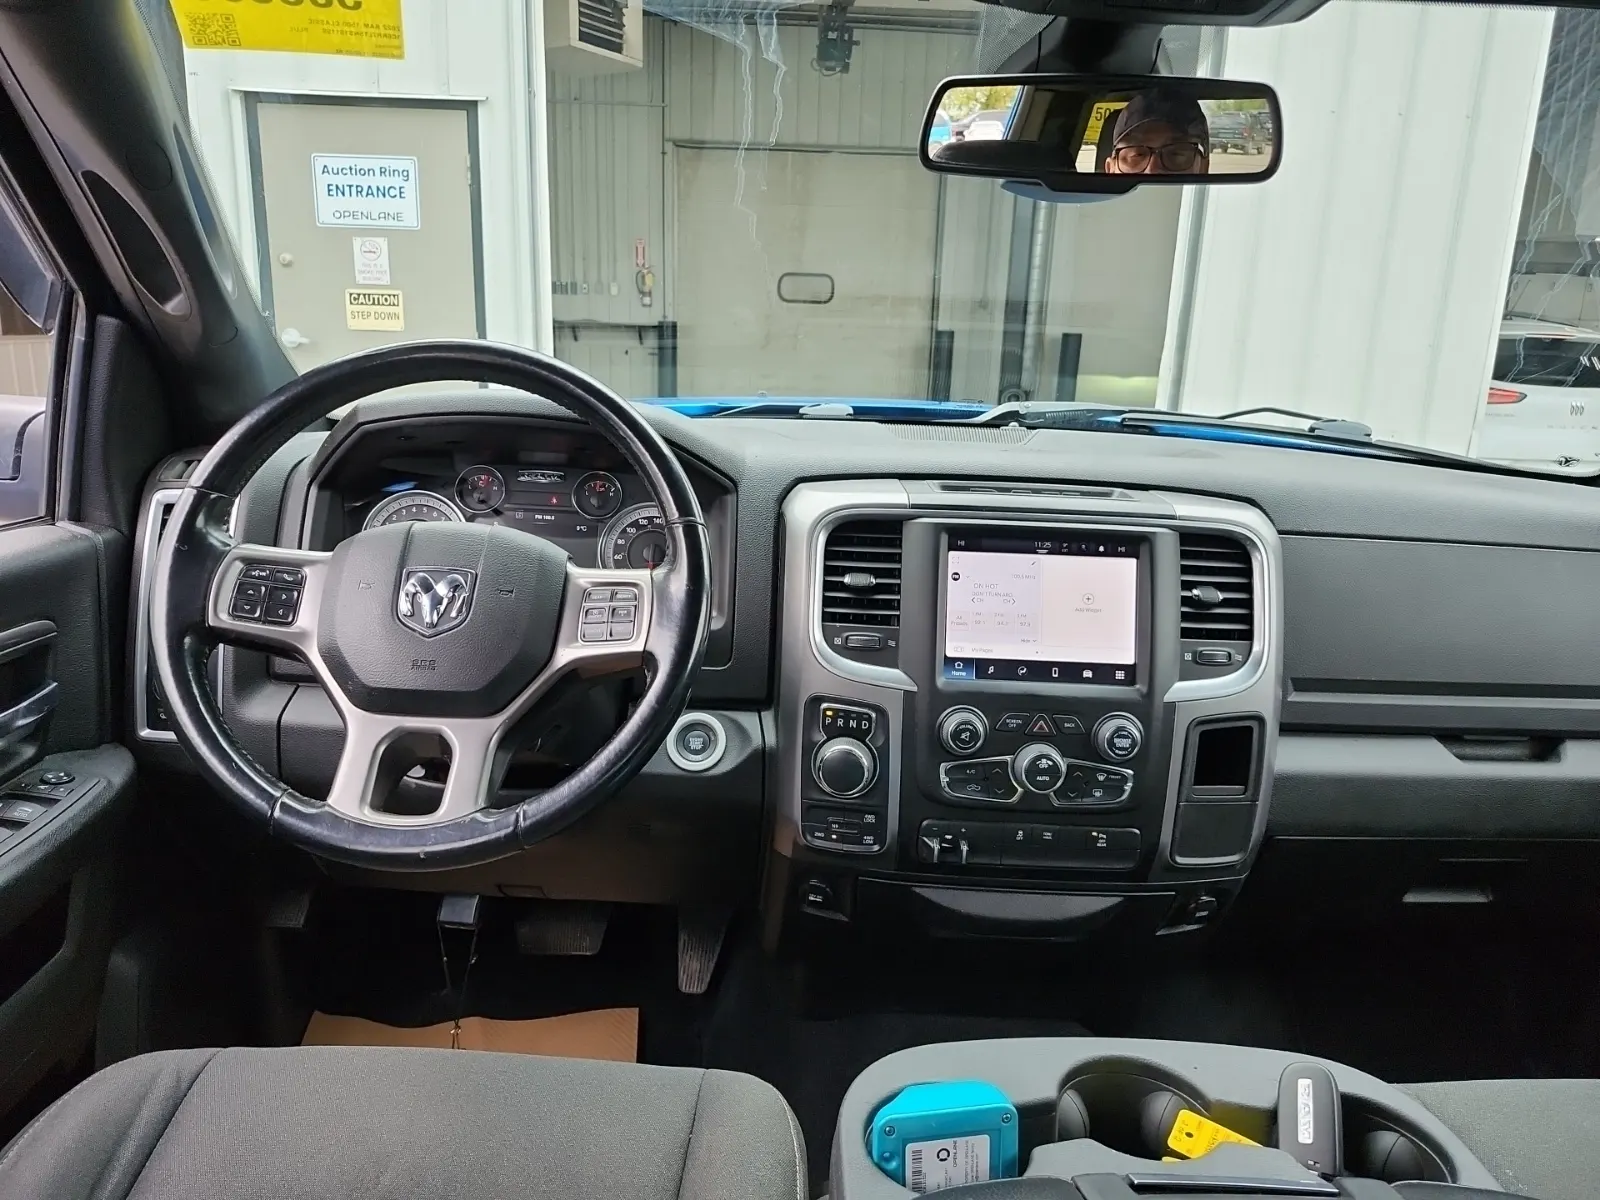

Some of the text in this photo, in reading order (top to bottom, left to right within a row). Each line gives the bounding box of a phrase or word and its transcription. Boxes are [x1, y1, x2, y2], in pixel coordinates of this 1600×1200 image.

[321, 164, 410, 182] Auction Ring
[327, 183, 406, 199] ENTRANCE
[332, 210, 405, 222] OPENLANE
[350, 294, 398, 306] CAUTION
[350, 311, 400, 321] STEP DOWN
[1034, 541, 1052, 549] 11:25
[825, 717, 832, 726] P
[837, 718, 844, 727] R
[849, 719, 857, 728] N
[861, 720, 869, 729] D
